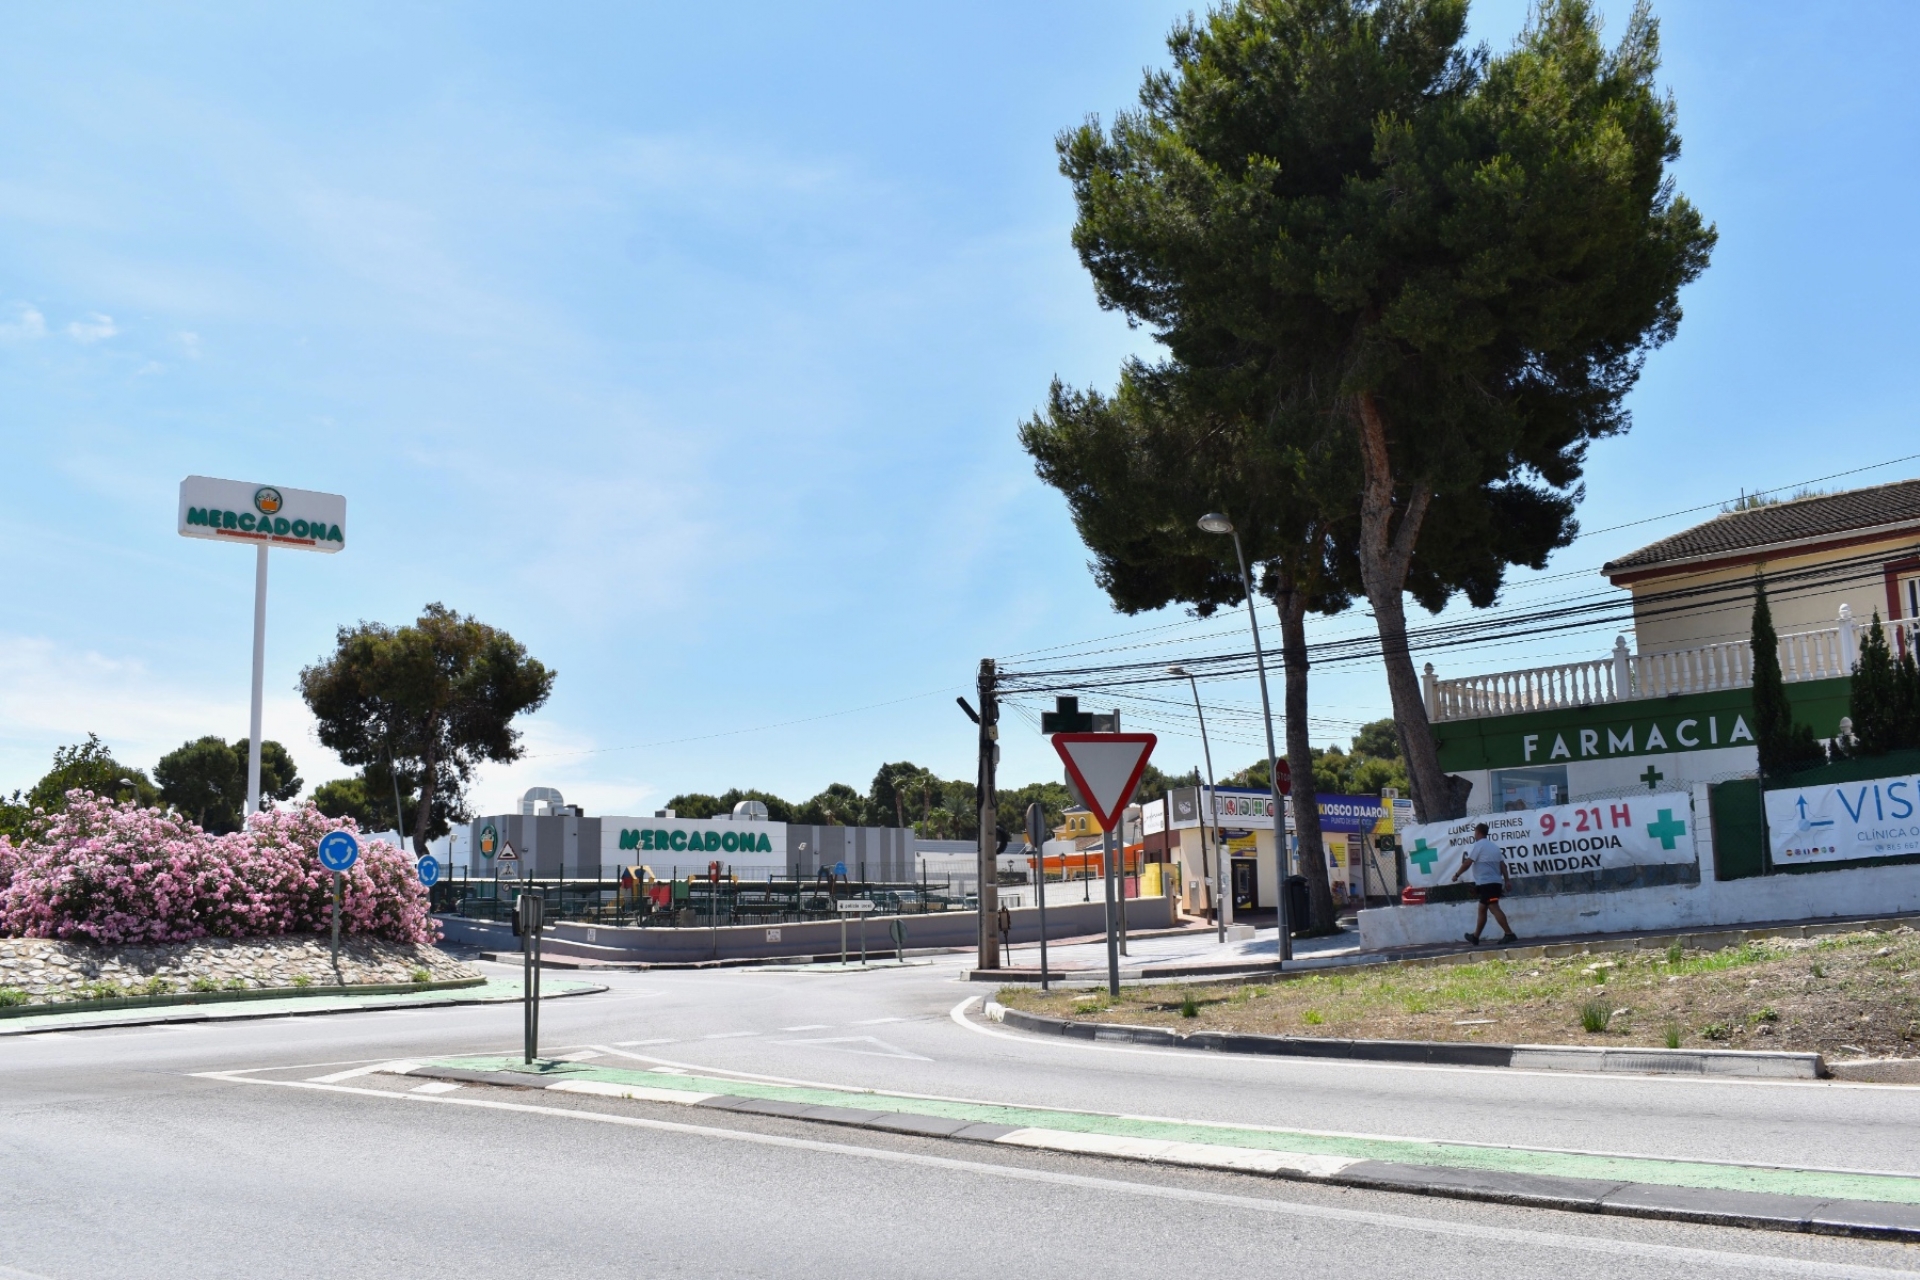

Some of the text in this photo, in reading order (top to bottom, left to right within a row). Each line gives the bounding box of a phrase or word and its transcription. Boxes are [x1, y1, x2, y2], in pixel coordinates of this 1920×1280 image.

[187, 506, 343, 543] MERCADONA
[1523, 714, 1754, 762] FARMACIA
[1318, 803, 1352, 817] KIOSCO
[1836, 780, 1920, 824] VIS
[1448, 817, 1523, 835] LUNES VIERNES
[1539, 813, 1556, 837] 9
[1575, 807, 1603, 833] 21
[1610, 803, 1631, 828] H
[619, 828, 772, 853] MERCADONA
[1449, 829, 1531, 847] MOND TO FRIDAY
[1532, 834, 1622, 857] MEDIODIA
[1533, 854, 1602, 874] MIDDAY
